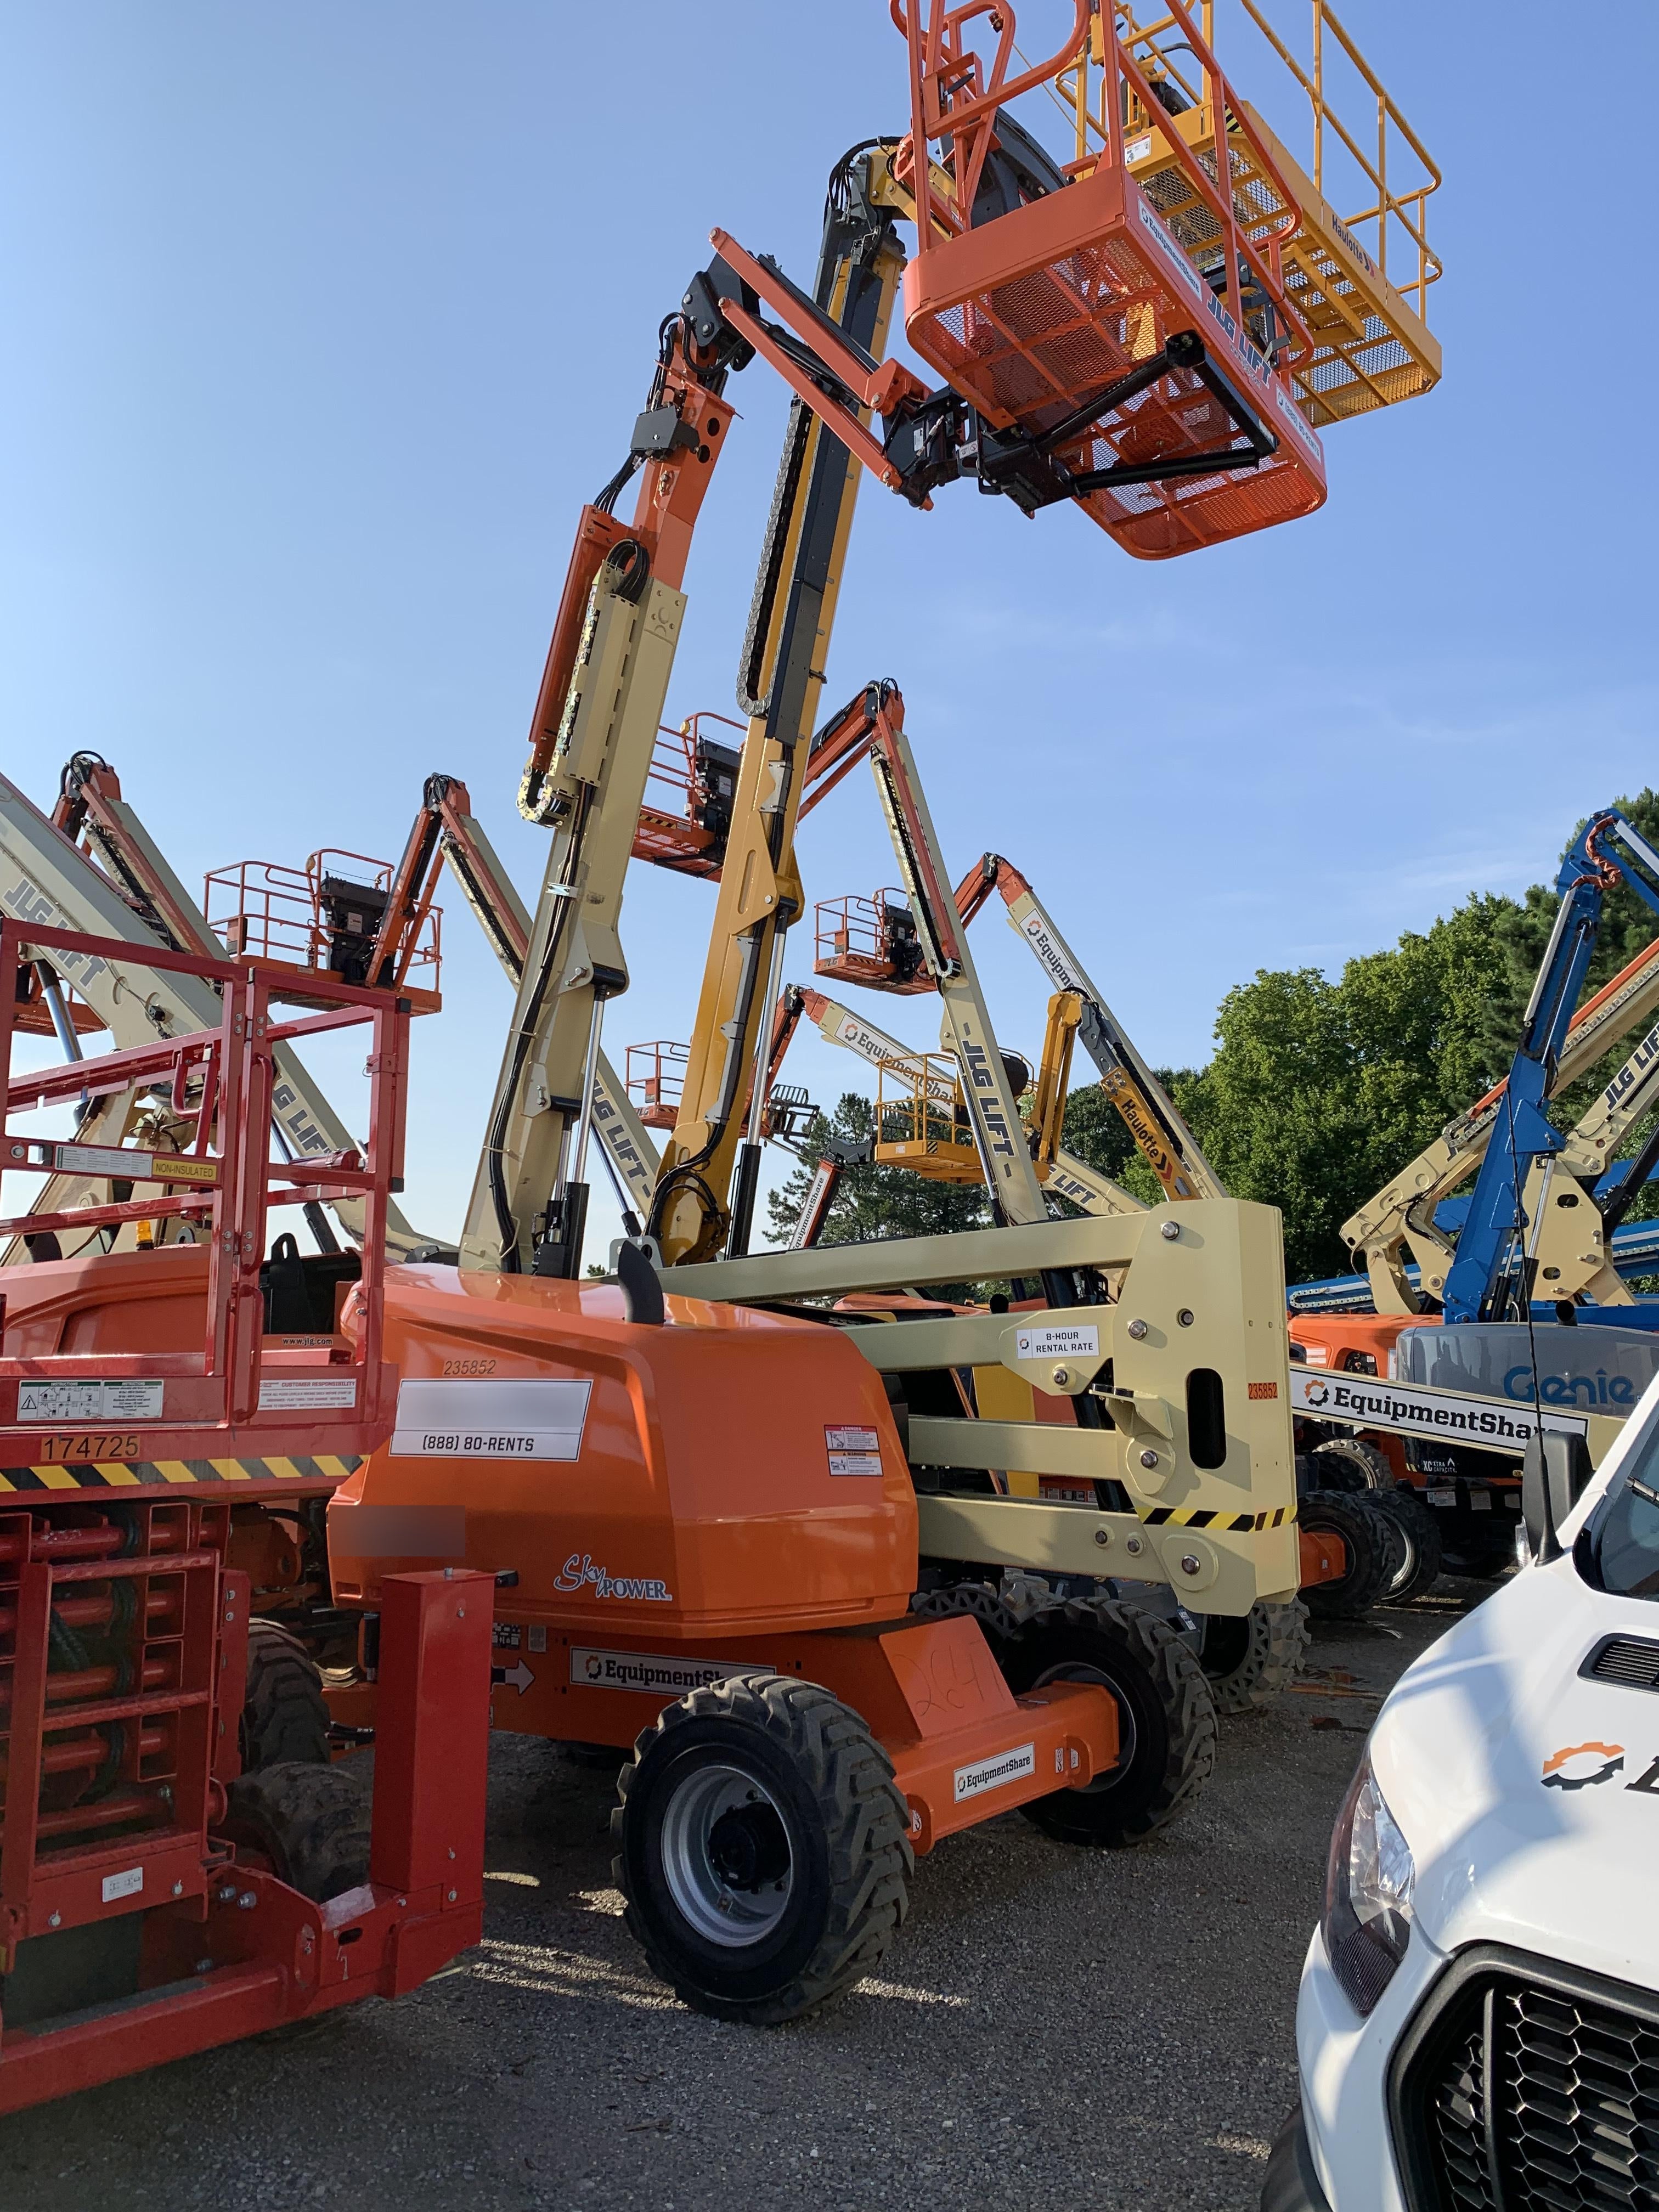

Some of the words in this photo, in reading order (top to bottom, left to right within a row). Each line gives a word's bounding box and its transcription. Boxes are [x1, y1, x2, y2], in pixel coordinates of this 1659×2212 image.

[1332, 214, 1363, 264] Haulotte
[1149, 218, 1200, 294] EquipmentShare
[1206, 293, 1236, 343] JLG
[1238, 330, 1272, 387] LIFT
[962, 1040, 995, 1087] JLG
[979, 1097, 1015, 1156] LIFT
[1604, 1061, 1636, 1111] JLG
[1121, 1098, 1159, 1159] Haulotte
[606, 1124, 648, 1178] LIFT
[155, 1163, 213, 1177] NON-INSULATED
[1053, 1173, 1098, 1205] LIFT
[283, 1337, 332, 1346] www.jlg.com
[1036, 1344, 1068, 1353] RENTAL
[1071, 1342, 1093, 1351] RATE
[1046, 1331, 1079, 1341] 8-HOUR
[443, 1359, 496, 1376] 235852
[1248, 1383, 1278, 1400] 235852
[1504, 1365, 1635, 1404] Genie
[1333, 1386, 1560, 1441] EquipmentSha
[44, 1436, 138, 1460] 174725
[422, 1434, 459, 1451] (888)
[464, 1435, 534, 1453] 80-RENTS
[1423, 1460, 1433, 1472] XC
[967, 1755, 1031, 1788] EquipmentShare
